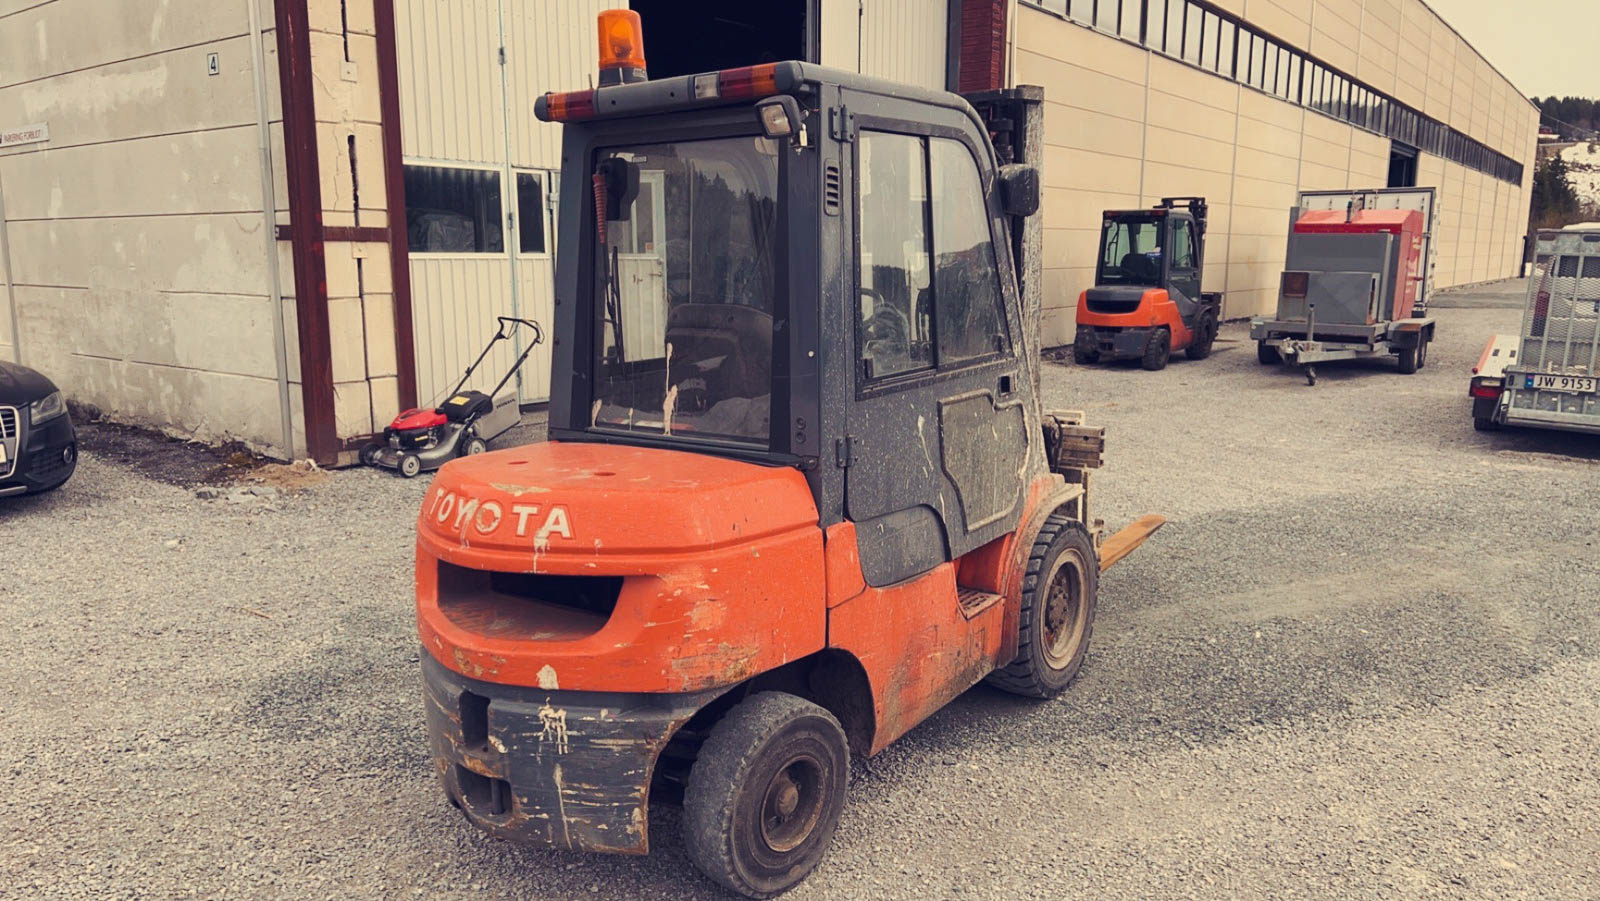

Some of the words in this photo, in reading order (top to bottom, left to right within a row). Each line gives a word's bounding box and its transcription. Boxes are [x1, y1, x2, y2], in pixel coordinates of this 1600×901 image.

[210, 55, 216, 72] 4
[1537, 376, 1556, 388] JW
[1561, 378, 1592, 390] 9153
[430, 488, 572, 538] TOYOTA
